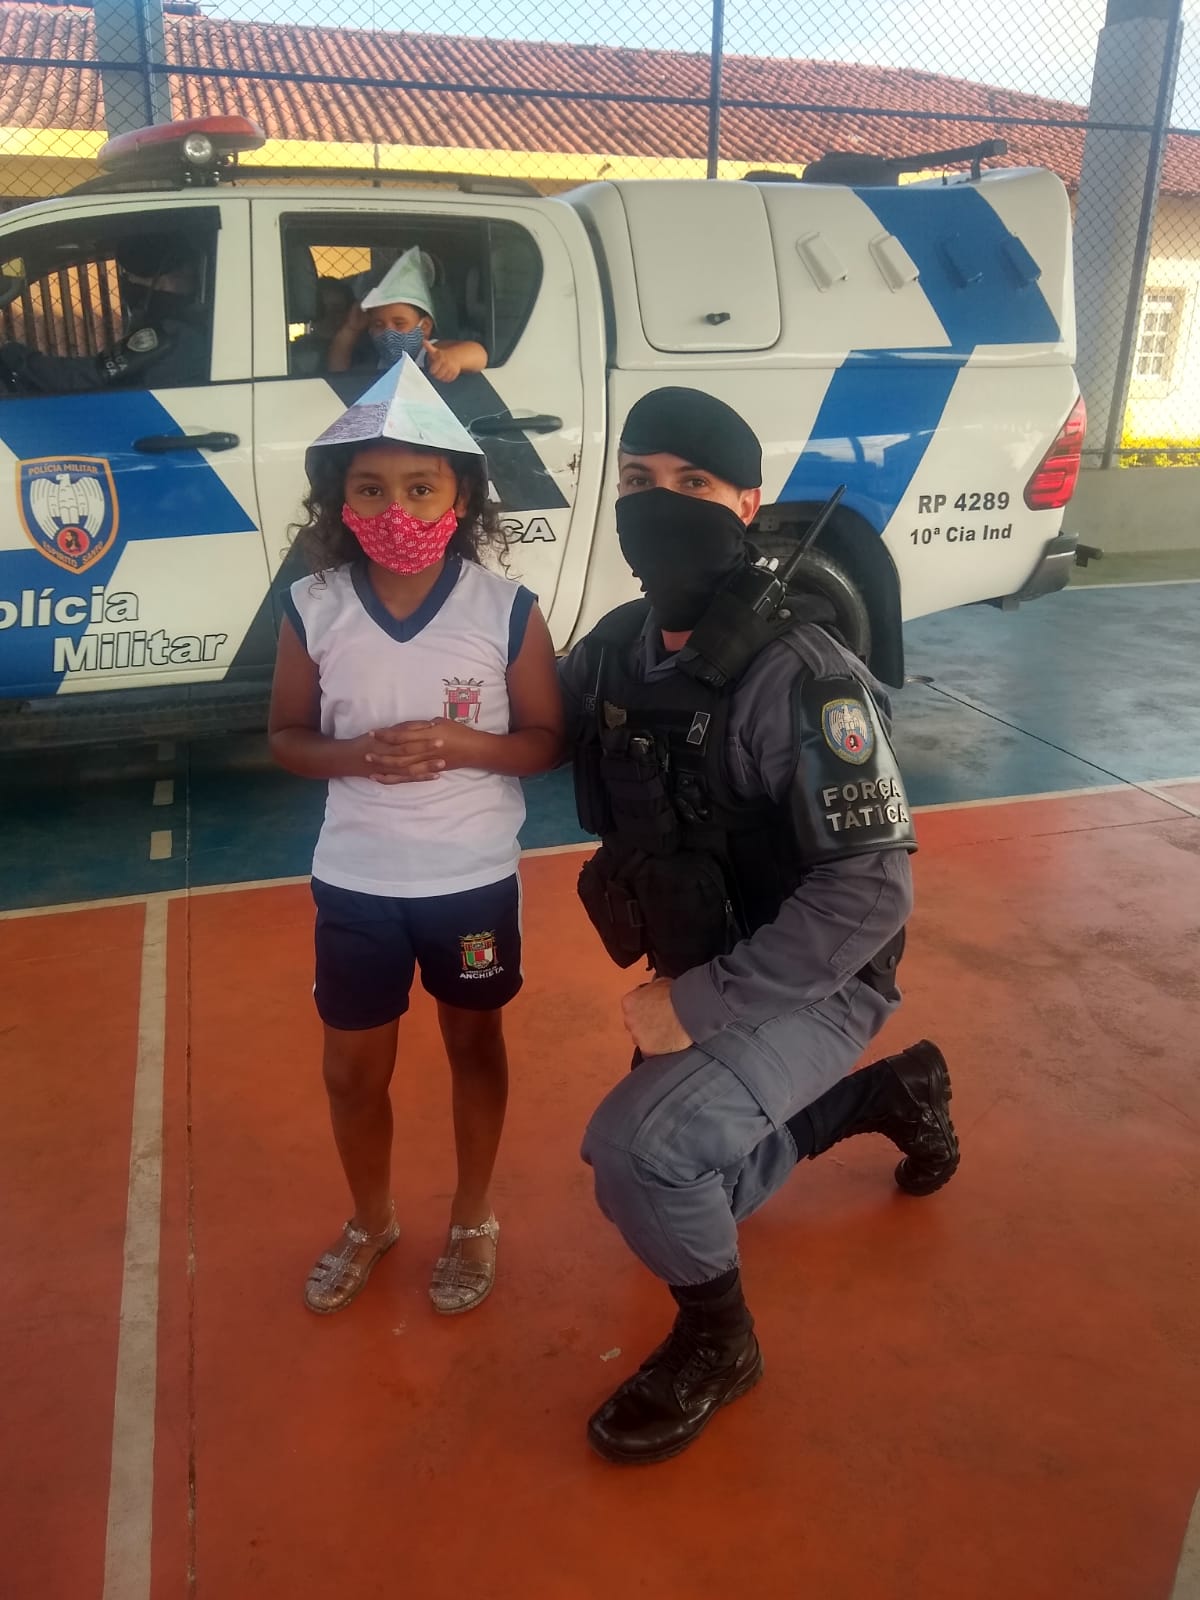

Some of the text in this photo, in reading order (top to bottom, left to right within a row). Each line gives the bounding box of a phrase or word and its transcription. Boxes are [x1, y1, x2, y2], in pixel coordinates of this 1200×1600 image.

[63, 463, 98, 474] MILITAR
[918, 491, 1010, 514] RP 4289
[946, 526, 976, 542] Cia
[982, 523, 1013, 540] Ind
[53, 630, 228, 673] Militar
[822, 778, 902, 807] FORÇA
[459, 966, 505, 979] ANCHIETA
